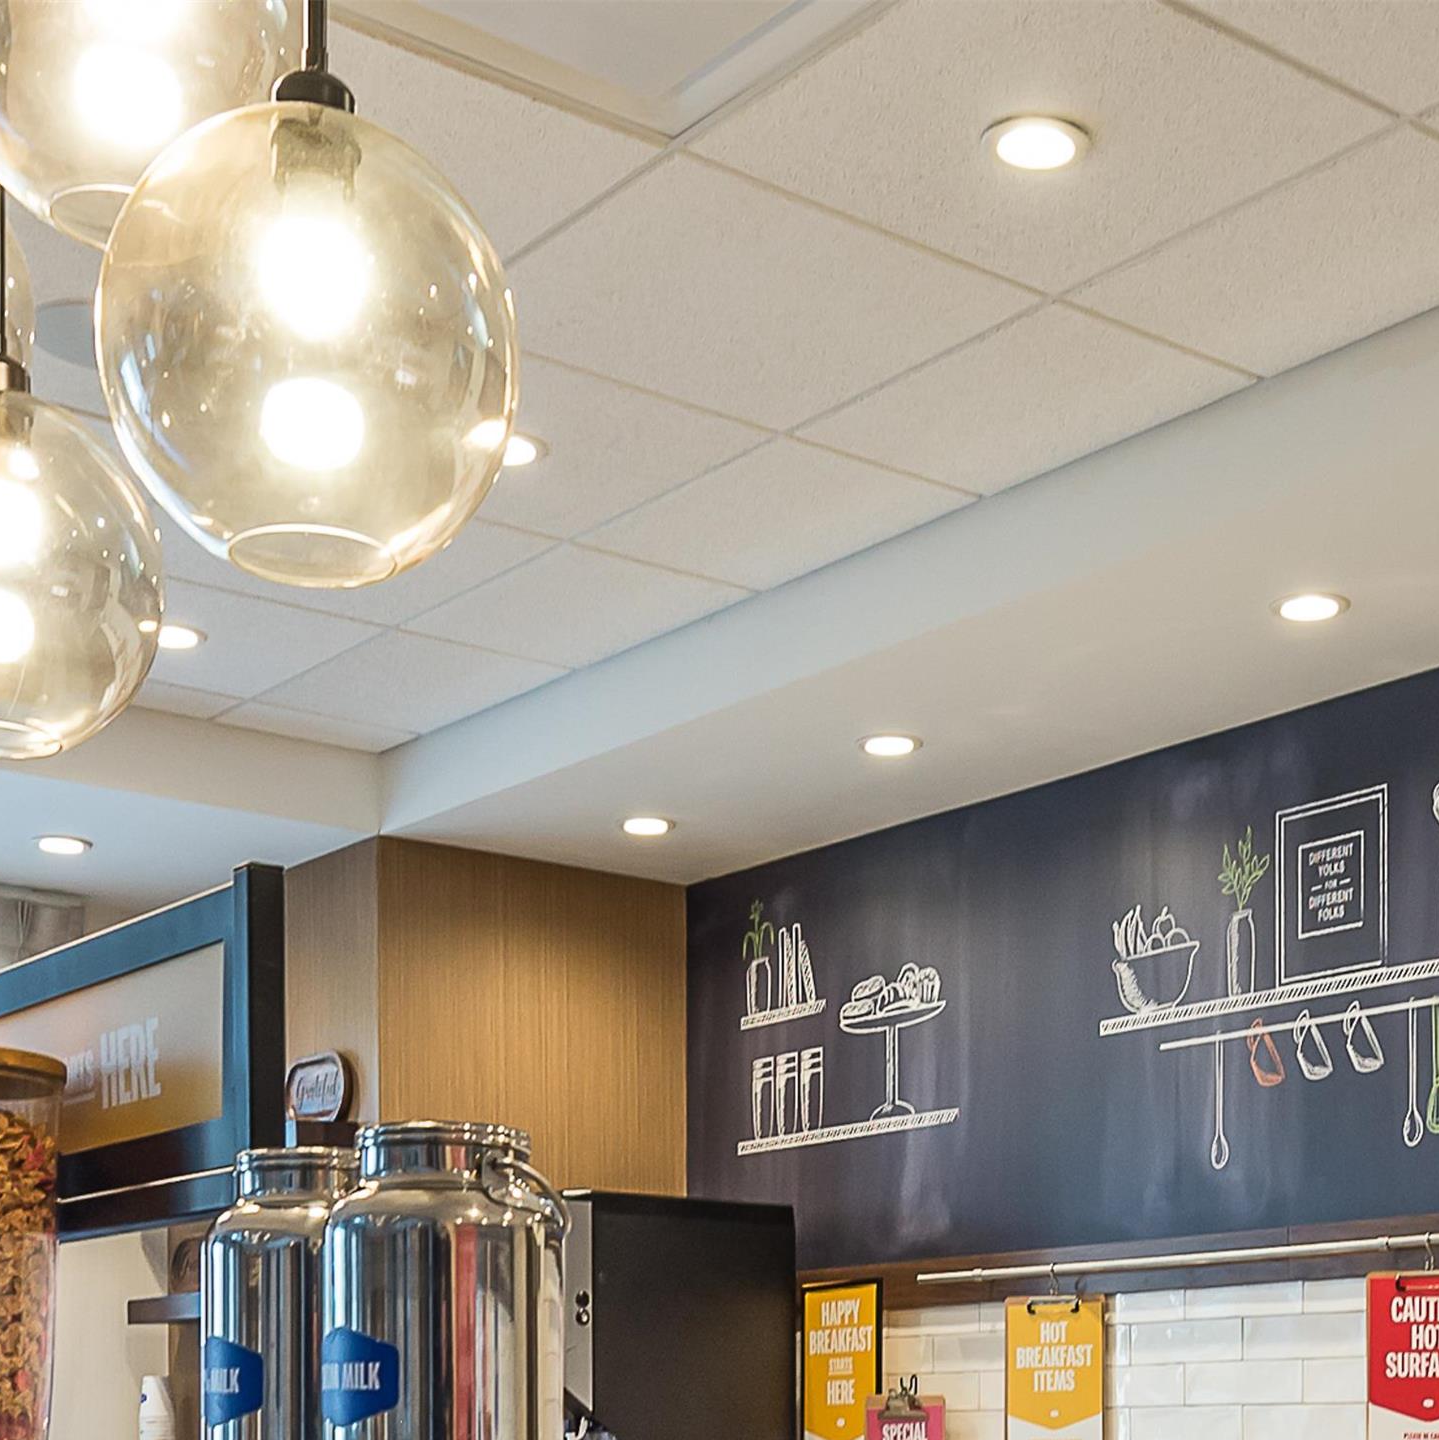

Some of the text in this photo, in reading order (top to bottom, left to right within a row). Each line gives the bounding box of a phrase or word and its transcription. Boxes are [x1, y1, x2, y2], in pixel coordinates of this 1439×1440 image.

[1308, 842, 1353, 866] DIFFERENT
[1318, 860, 1345, 878] YOLKS
[1308, 887, 1353, 910] DIFFERENT
[1317, 904, 1344, 922] FOLKS
[100, 1016, 162, 1110] HERE
[821, 1298, 860, 1327] HAPPY
[809, 1325, 872, 1356] BREAKFAST
[1039, 1320, 1068, 1344] HOT
[1015, 1343, 1094, 1370] BREAKFAST
[342, 1360, 381, 1391] MILK
[1033, 1368, 1075, 1393] ITEMS
[826, 1379, 855, 1406] HERE
